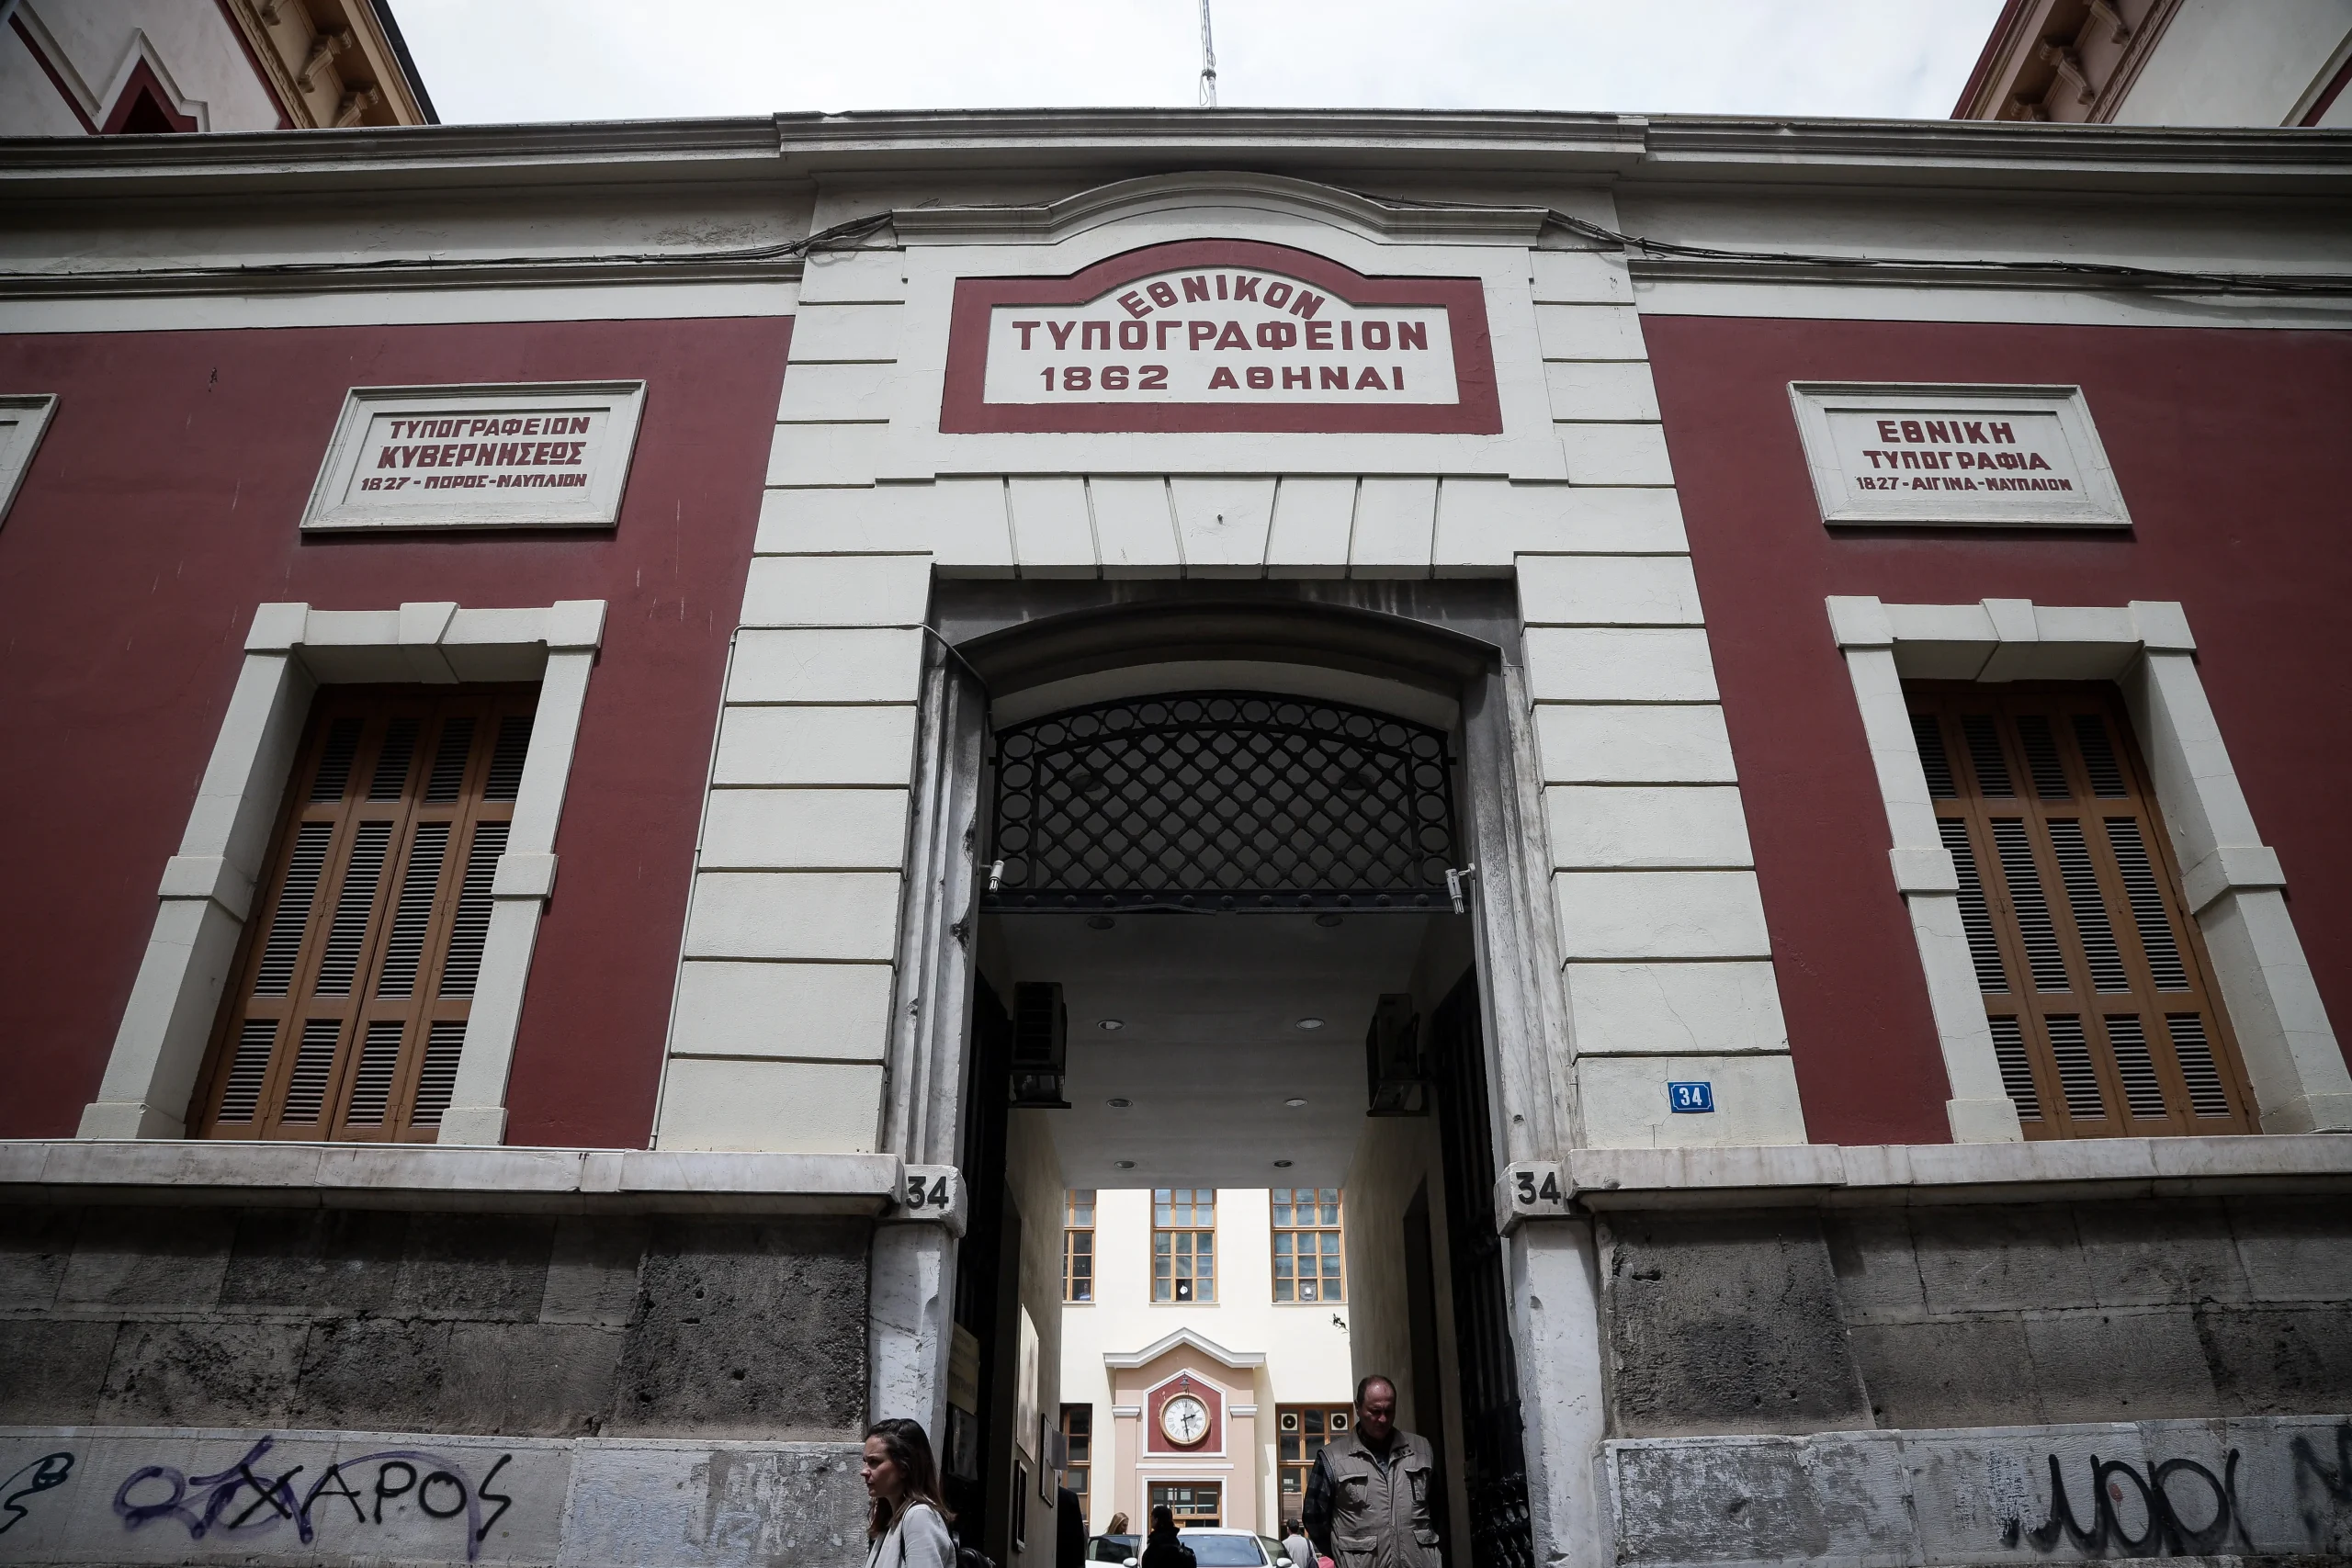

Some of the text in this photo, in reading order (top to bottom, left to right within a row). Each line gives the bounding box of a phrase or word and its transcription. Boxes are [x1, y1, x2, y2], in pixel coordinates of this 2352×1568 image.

[1116, 274, 1326, 320] ΕΘΝΙΚΟΝ
[1012, 320, 1429, 351] ΤΥΠΟΓΡΑΦΕΙΟΝ
[1039, 365, 1405, 391] 1862 ΑΘΗΝΑΙ
[390, 416, 591, 439] ΤΥΠΟΓΡΑΦΕΙΟΝ
[1876, 420, 2017, 444] ΕΘΝΙΚΗ
[377, 441, 587, 468] ΚΥΒΕΡΝΗΣΕΩΣ
[1862, 450, 2052, 470] ΤΥΠΟΓΡΑΦΙΑ
[1679, 1087, 1703, 1106] 34
[905, 1176, 950, 1210] 34
[1516, 1171, 1562, 1205] 34
